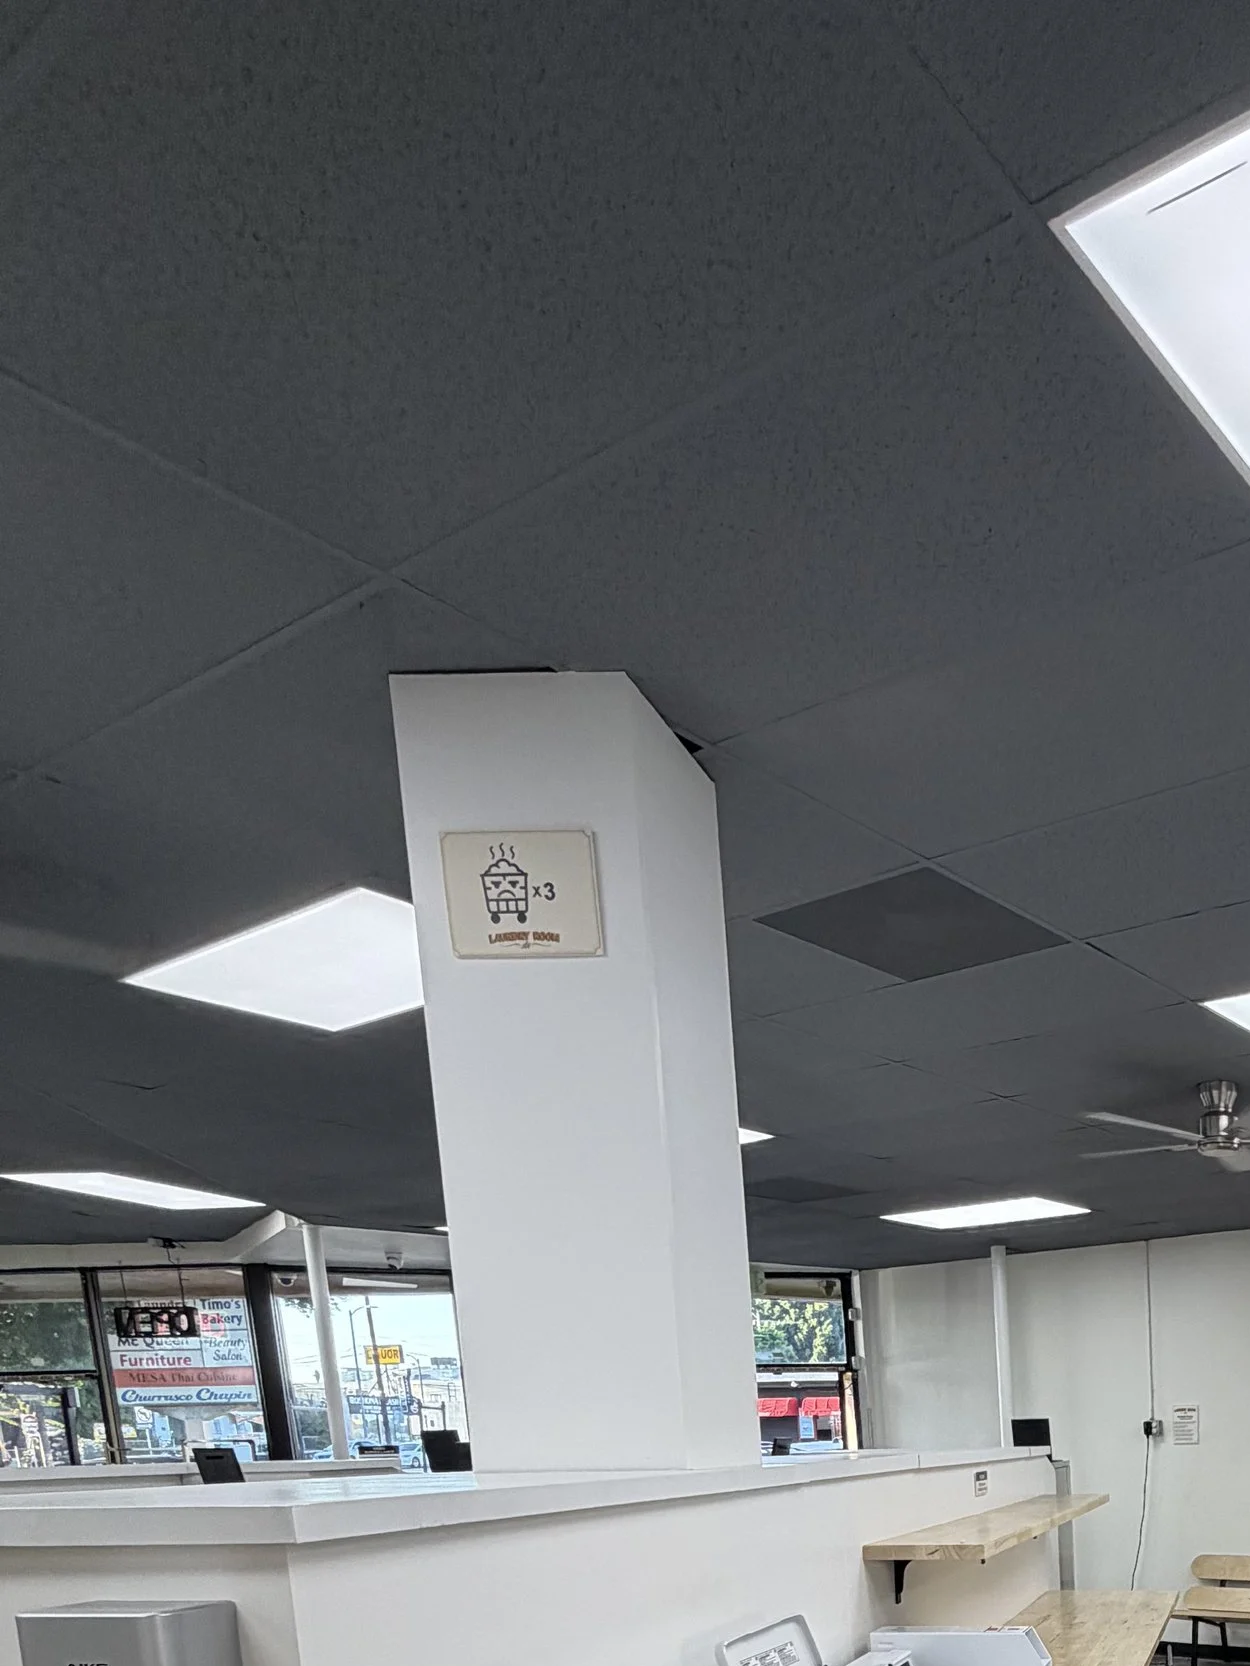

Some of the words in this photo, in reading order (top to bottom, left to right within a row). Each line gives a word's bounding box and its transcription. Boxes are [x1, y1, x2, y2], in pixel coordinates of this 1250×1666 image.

[201, 1299, 241, 1310] Timo's
[201, 1313, 243, 1326] Bakery
[209, 1337, 246, 1350] Beauty
[120, 1353, 192, 1367] Furniture
[213, 1349, 243, 1361] Salon
[366, 1348, 399, 1360] LUOR
[121, 1389, 193, 1403] Churrasco
[195, 1388, 252, 1402] Chapin
